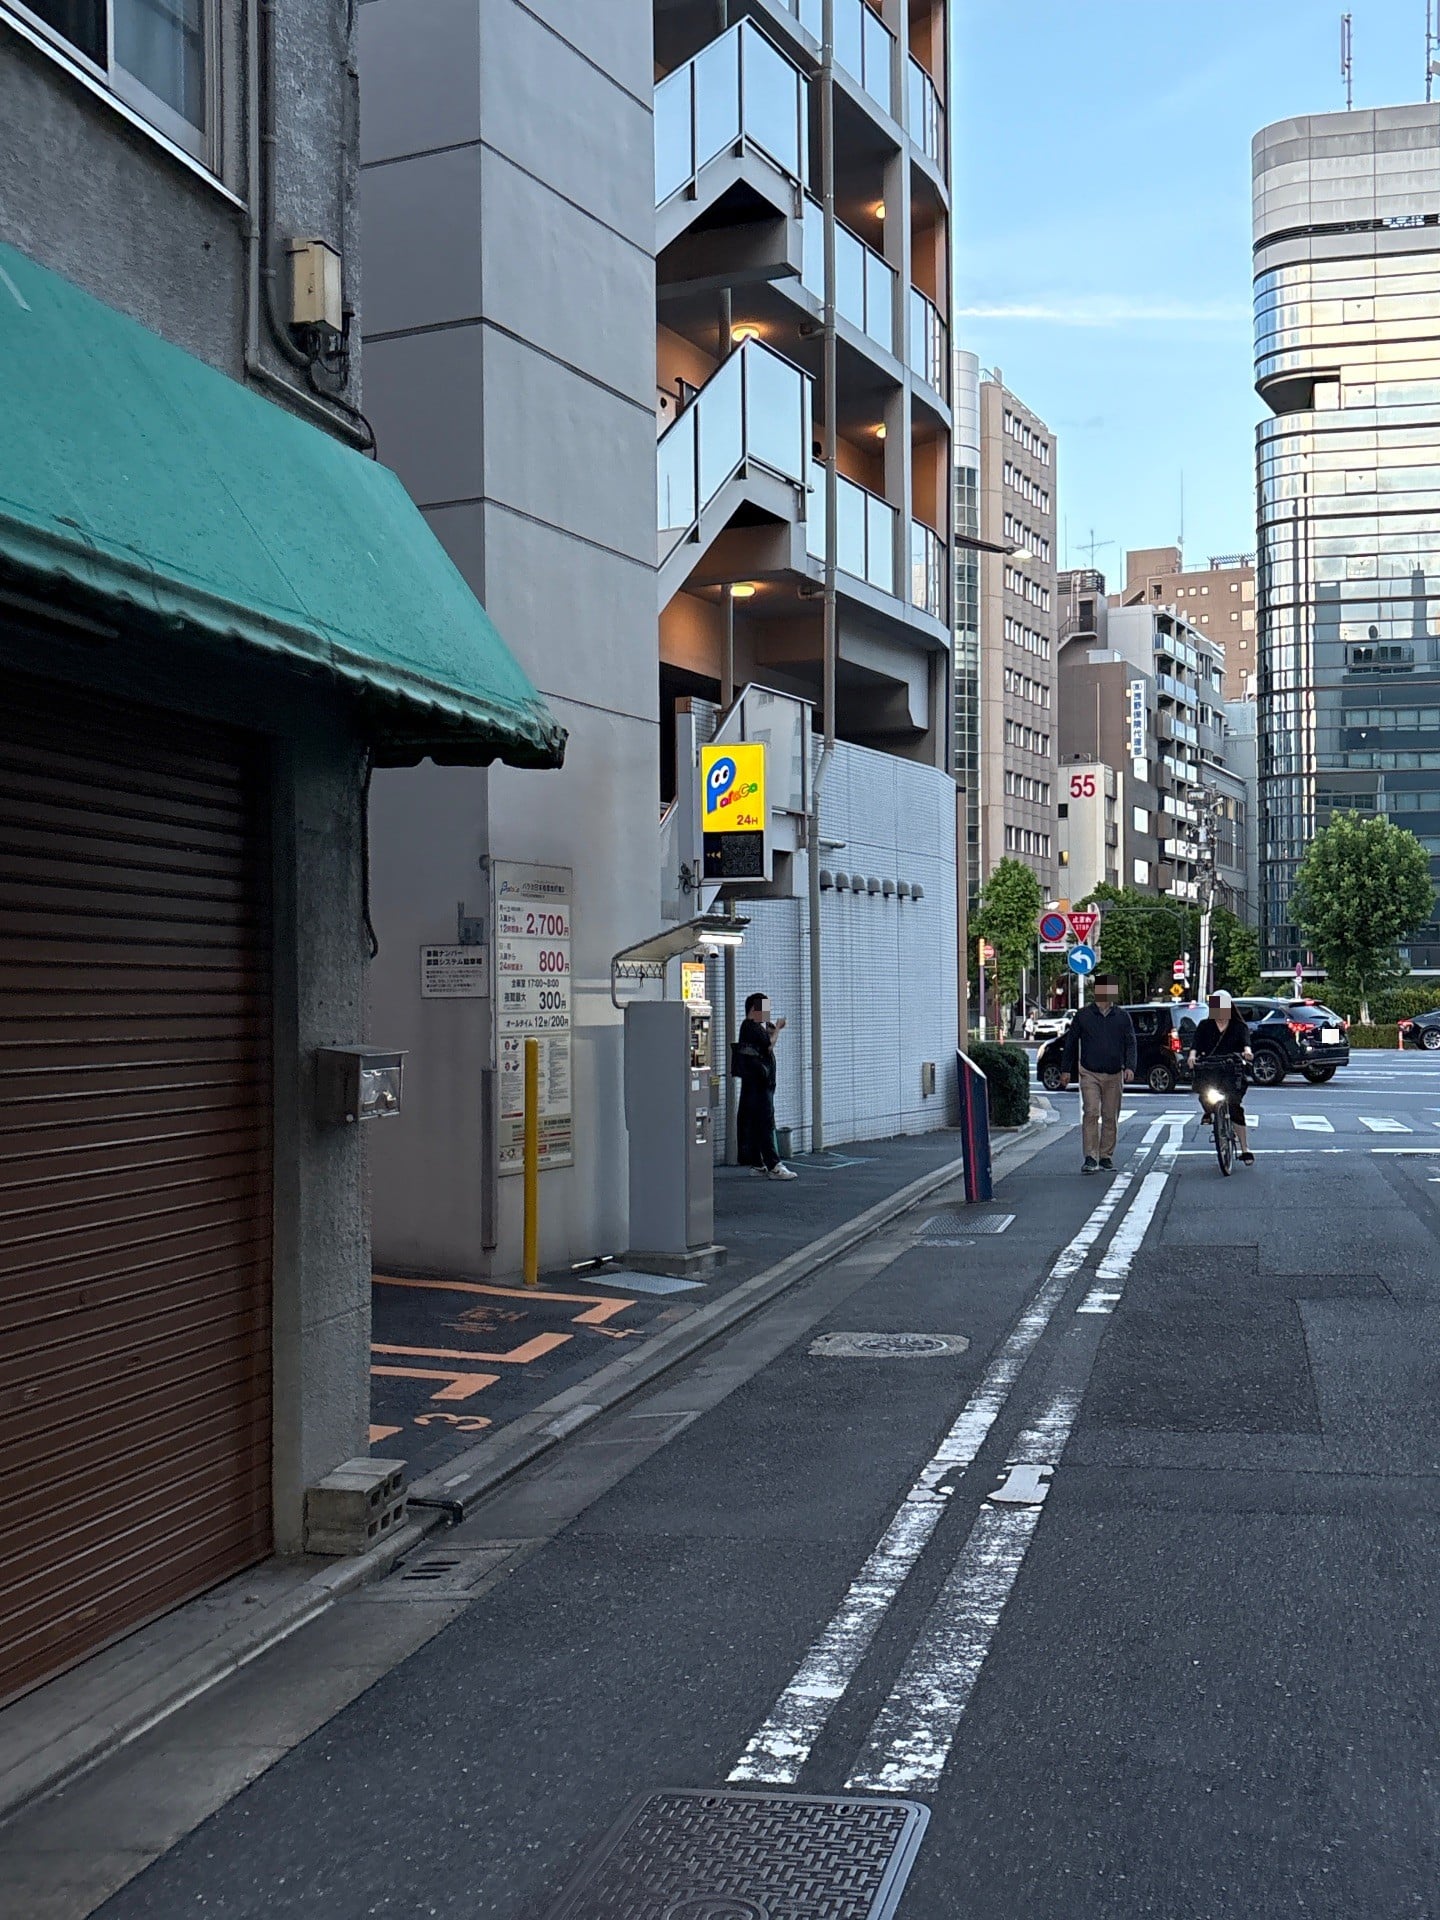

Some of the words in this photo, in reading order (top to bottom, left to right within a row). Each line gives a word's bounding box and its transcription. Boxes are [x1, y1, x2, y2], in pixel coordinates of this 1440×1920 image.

[1070, 774, 1096, 799] 55
[736, 815, 758, 825] 24H
[1072, 915, 1092, 923] 止まれ
[505, 1019, 533, 1027] オールタイム
[588, 1326, 645, 1338] 4
[413, 1412, 492, 1431] 3
